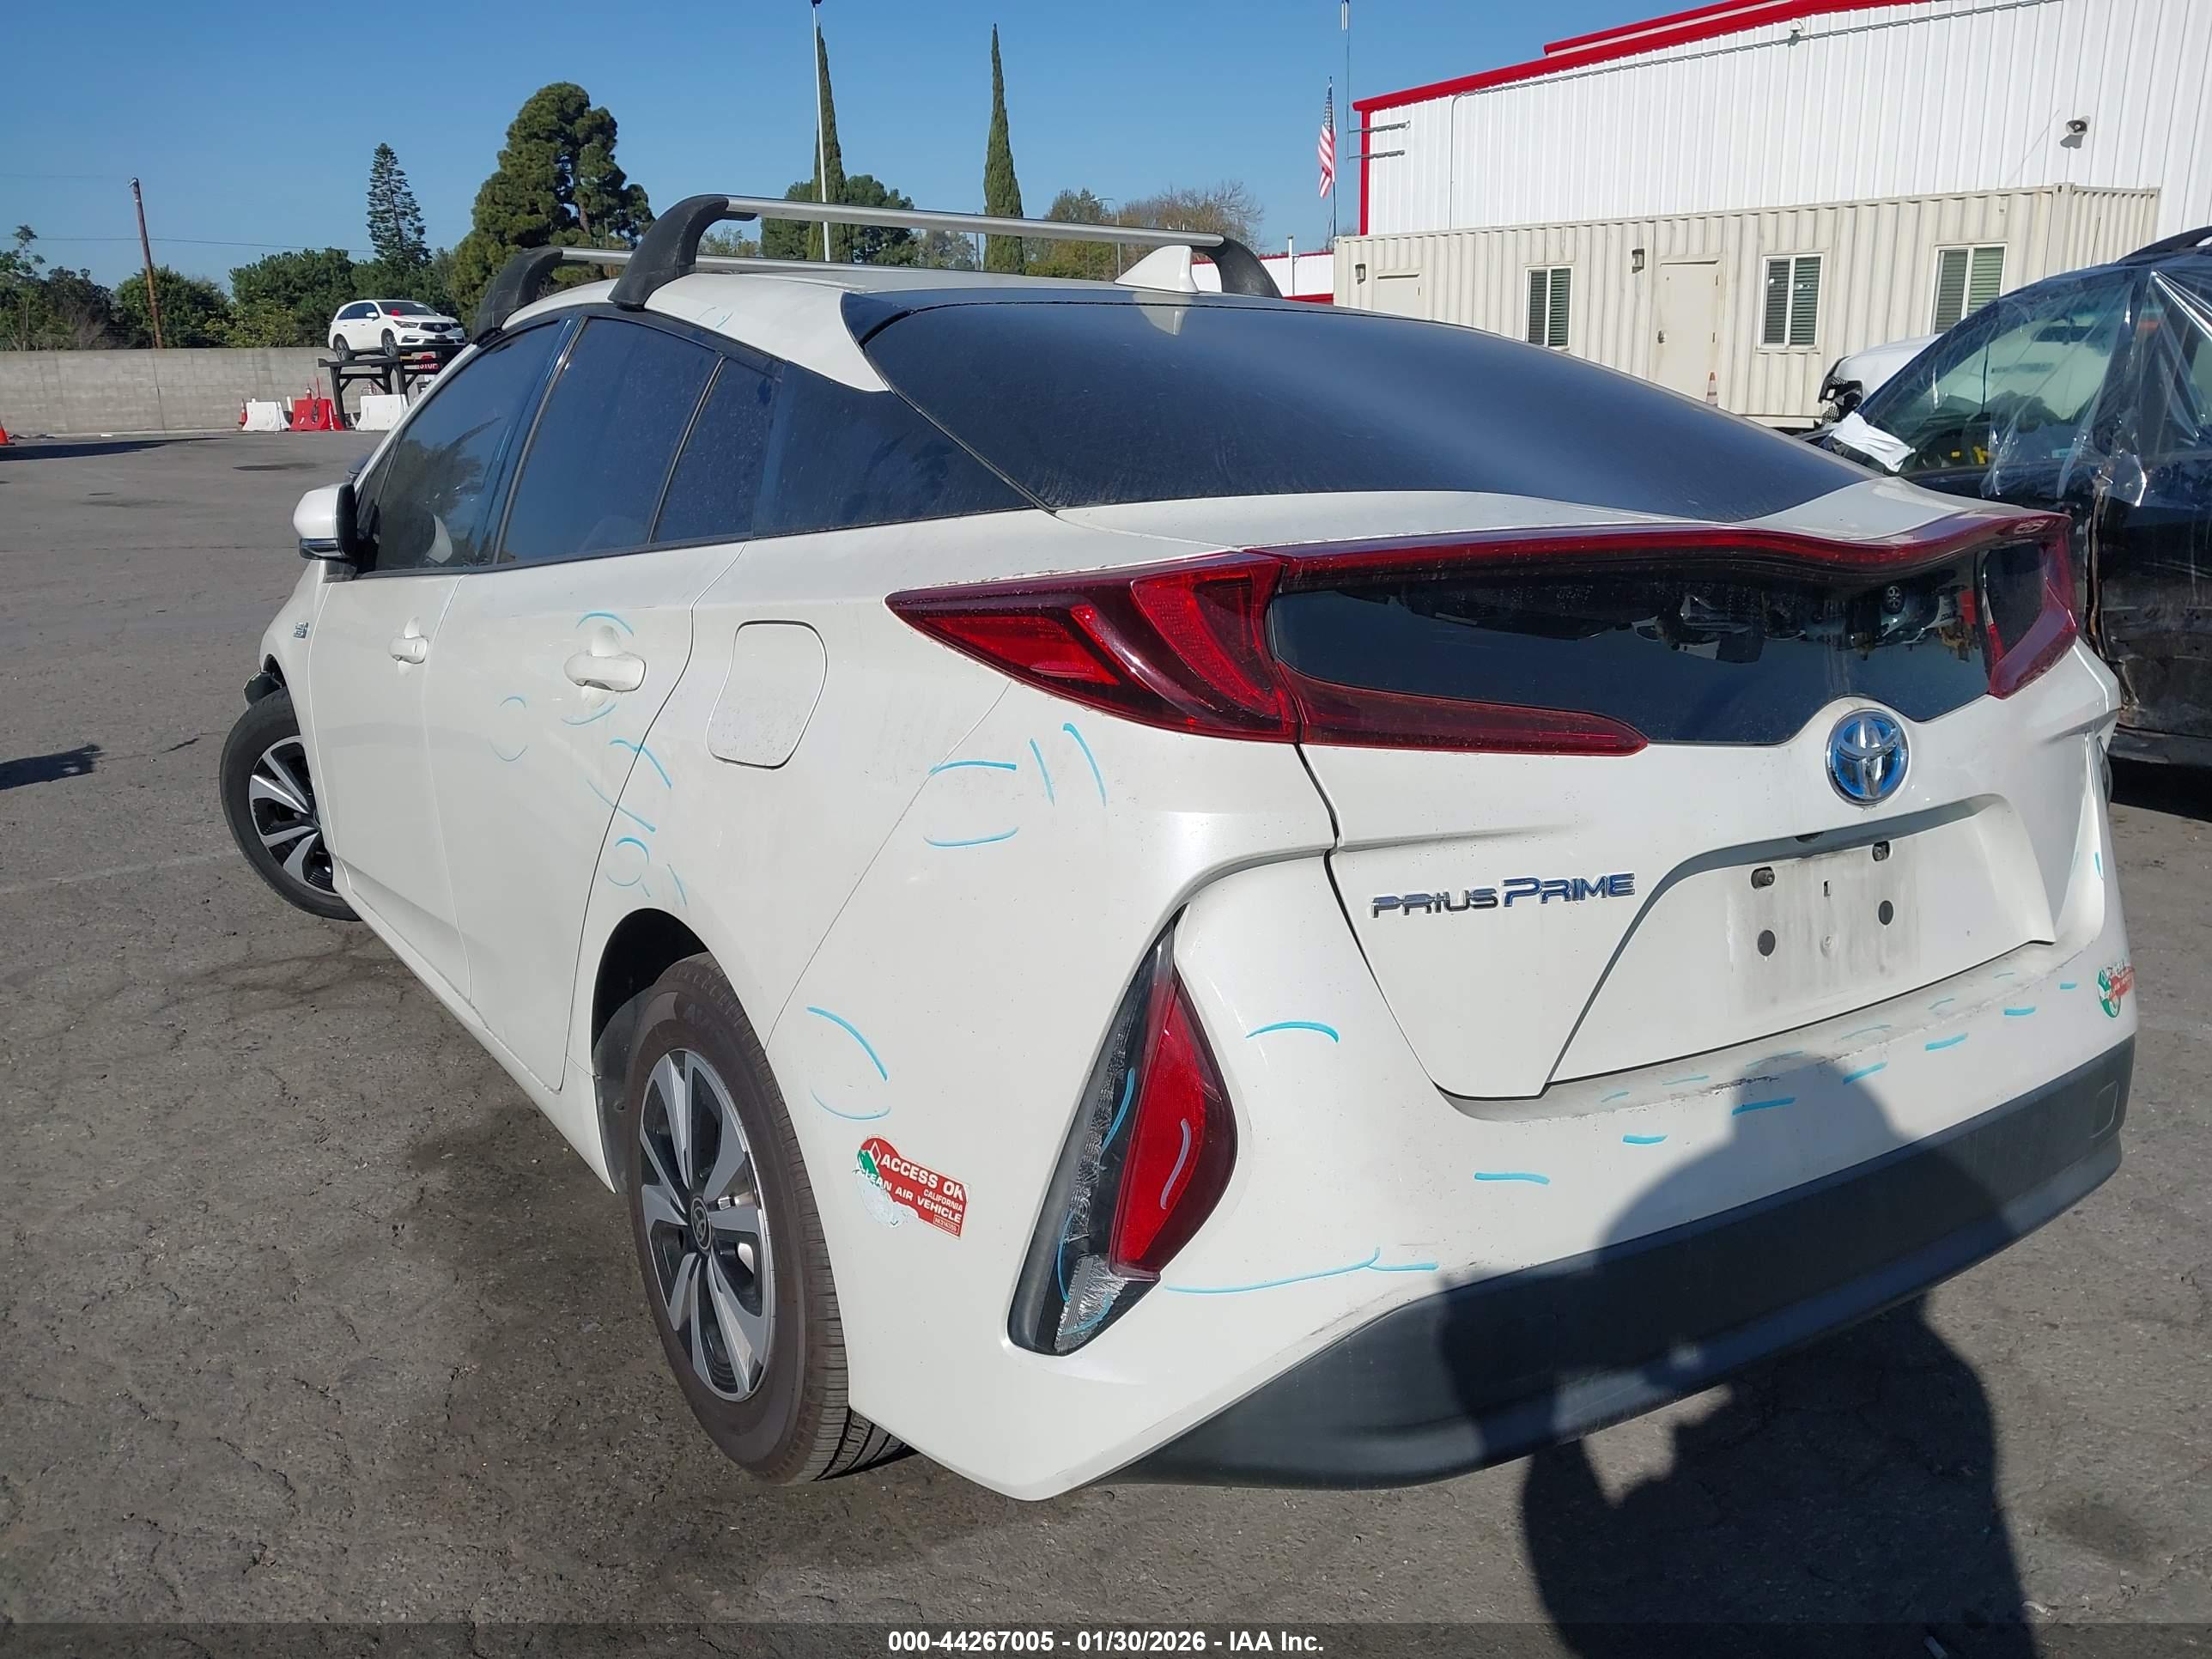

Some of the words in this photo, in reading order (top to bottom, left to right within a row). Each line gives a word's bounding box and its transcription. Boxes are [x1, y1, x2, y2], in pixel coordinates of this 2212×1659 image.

[1371, 887, 1499, 919] PRIUS
[1502, 872, 1635, 908] PRIME
[880, 1154, 938, 1188] ACCESS
[943, 1181, 963, 1201] OK
[895, 1187, 914, 1201] AIR
[917, 1195, 962, 1223] VEHICLE
[923, 1189, 963, 1212] CALIFORNIA
